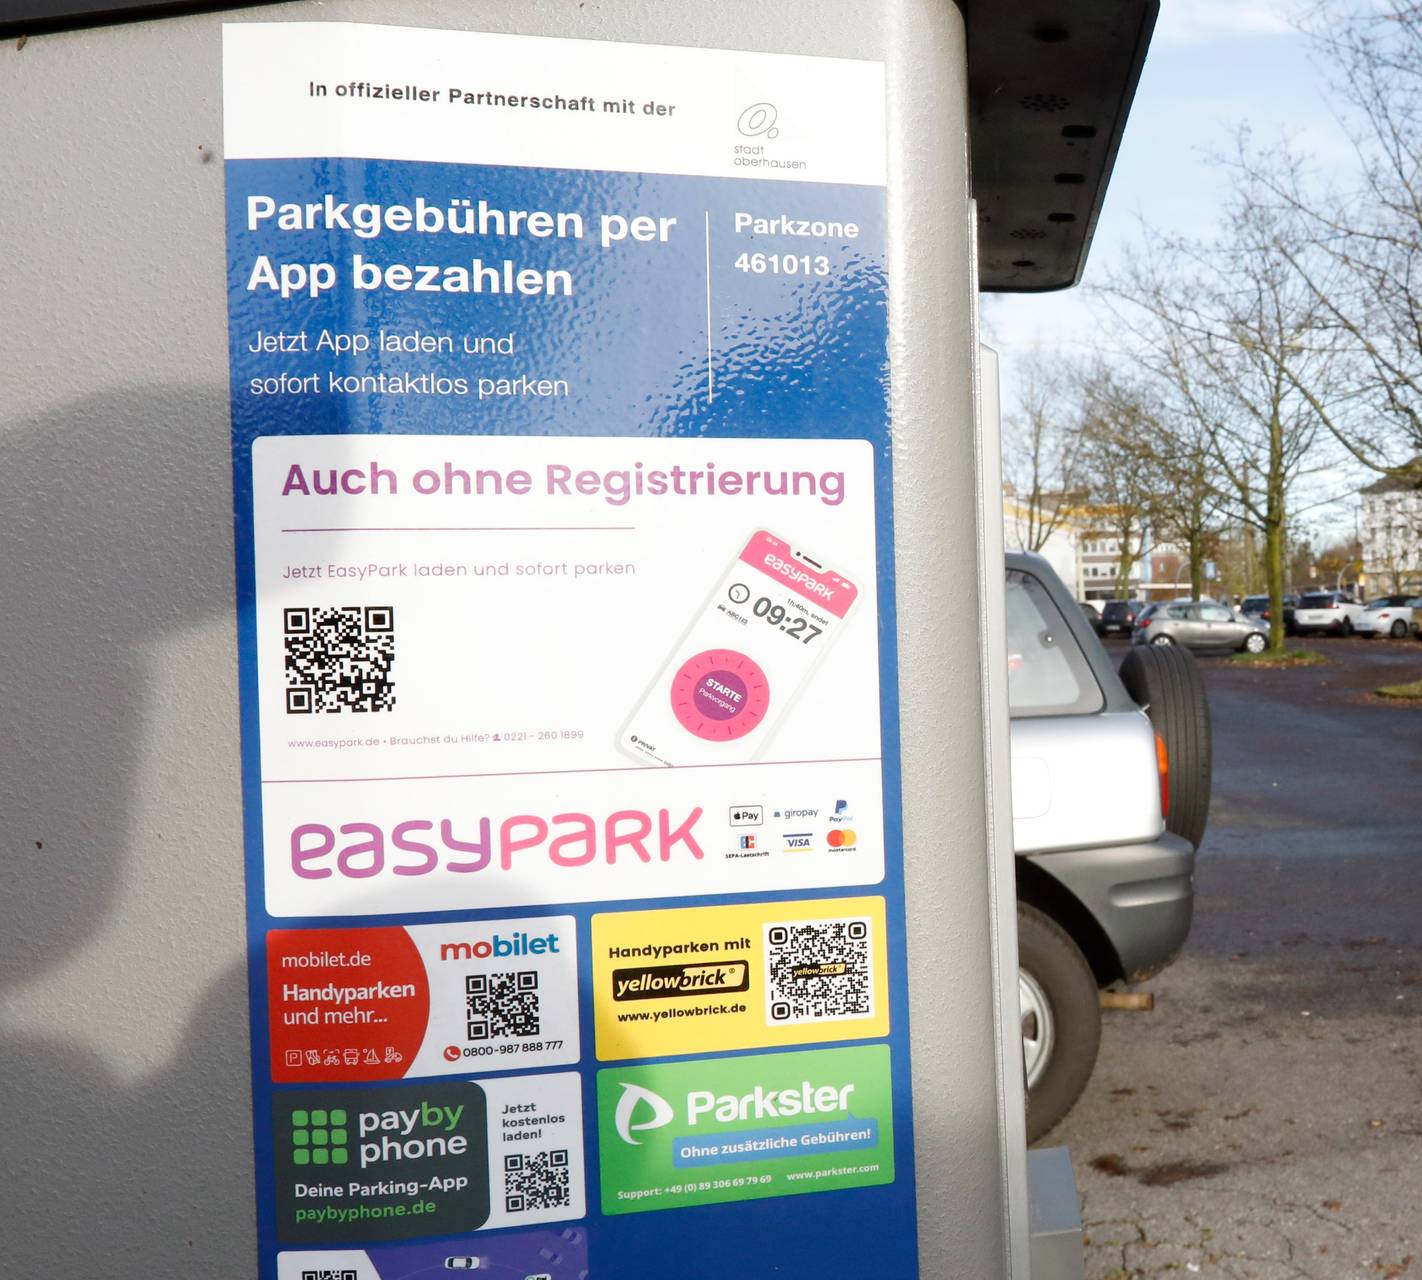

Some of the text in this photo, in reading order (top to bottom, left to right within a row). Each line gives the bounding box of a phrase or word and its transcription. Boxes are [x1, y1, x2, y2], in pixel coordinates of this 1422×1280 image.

[309, 81, 675, 117] In offizieller Partnerschaft mit der
[733, 145, 764, 154] stadt
[734, 157, 807, 169] oberhausen
[246, 196, 676, 247] Parkgebühren per
[735, 213, 859, 239] Parkzone
[734, 253, 830, 276] 461013
[247, 256, 572, 298] App bezahlen
[248, 331, 514, 357] Jetzt App laden und
[250, 372, 568, 401] sofort kontaktlos parken
[281, 463, 845, 506] Auch ohne Registrierung
[283, 560, 636, 580] Jetzt EasyPark laden und sofort parken
[753, 597, 823, 644] 09:27
[699, 688, 736, 713] Parkvorgang
[706, 678, 742, 702] STARTE
[288, 738, 380, 749] www.easypark.de
[390, 736, 440, 746] Brauchst
[443, 735, 458, 744] du
[461, 734, 490, 743] Hilfe?
[504, 732, 527, 741] 0221
[538, 731, 558, 740] 260
[560, 730, 584, 740] 1899
[742, 812, 758, 821] Pay
[784, 809, 818, 819] giropay
[440, 932, 560, 962] mobilet
[608, 936, 751, 960] Handyparken mit
[281, 951, 371, 968] mobilet.de
[282, 981, 415, 1005] Handyparken
[284, 1006, 388, 1025] und mehr...
[617, 1002, 747, 1023] www.yellowbrick.de
[463, 1039, 564, 1057] 0800-987 888 777
[501, 1101, 537, 1114] Jetzt
[688, 1080, 854, 1125] Parkster
[502, 1113, 565, 1128] kostenlos
[502, 1128, 542, 1141] laden!
[680, 1128, 871, 1158] Ohne zusätzliche Gebühren!
[360, 1135, 467, 1168] phone
[294, 1173, 468, 1198] Deine Parking-App
[787, 1163, 879, 1184] www.parkster.com
[617, 1174, 771, 1201] Support: +49 (0) 89 306 69 79 69
[295, 1199, 437, 1224] paybyphone.de
